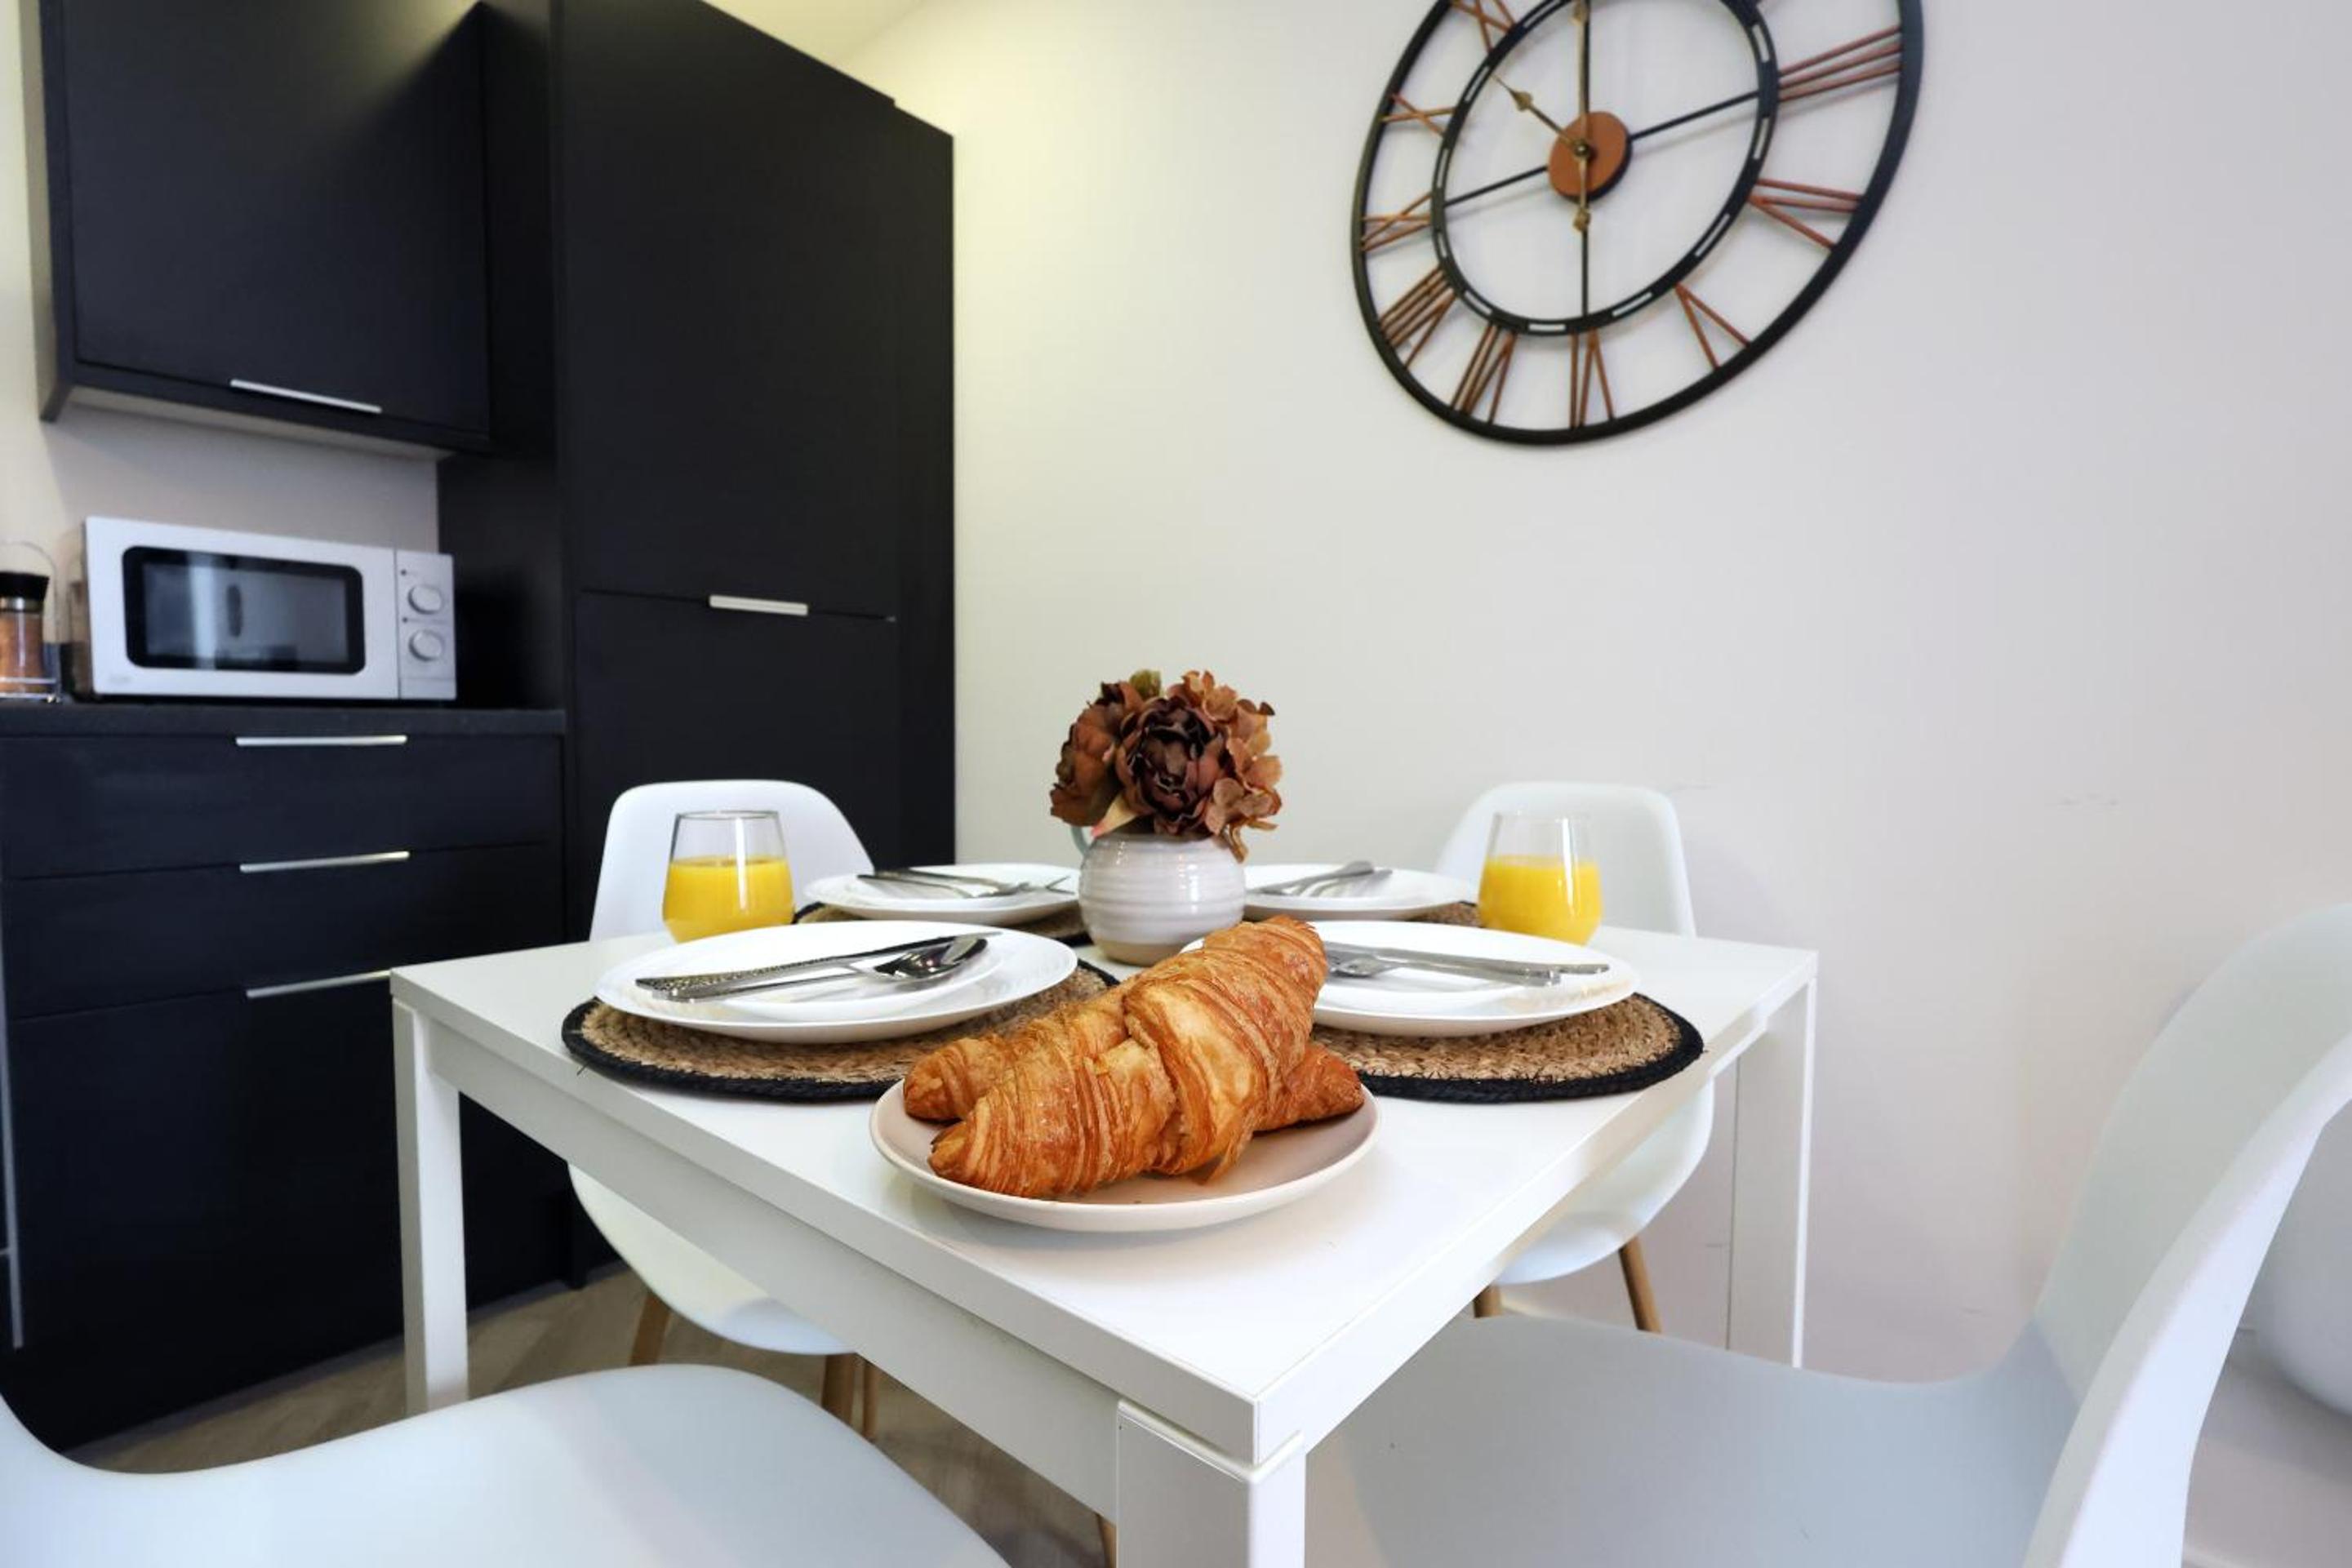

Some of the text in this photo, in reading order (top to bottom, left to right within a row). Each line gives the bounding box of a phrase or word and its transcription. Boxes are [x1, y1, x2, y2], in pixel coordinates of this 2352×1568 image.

[1776, 24, 1904, 103] III
[1381, 91, 1458, 137] X
[1360, 191, 1434, 253] IX
[1745, 176, 1865, 250] IV
[1378, 263, 1458, 369] VIII
[1674, 282, 1752, 370] V
[1452, 323, 1518, 424] VII
[1569, 328, 1618, 428] VI
